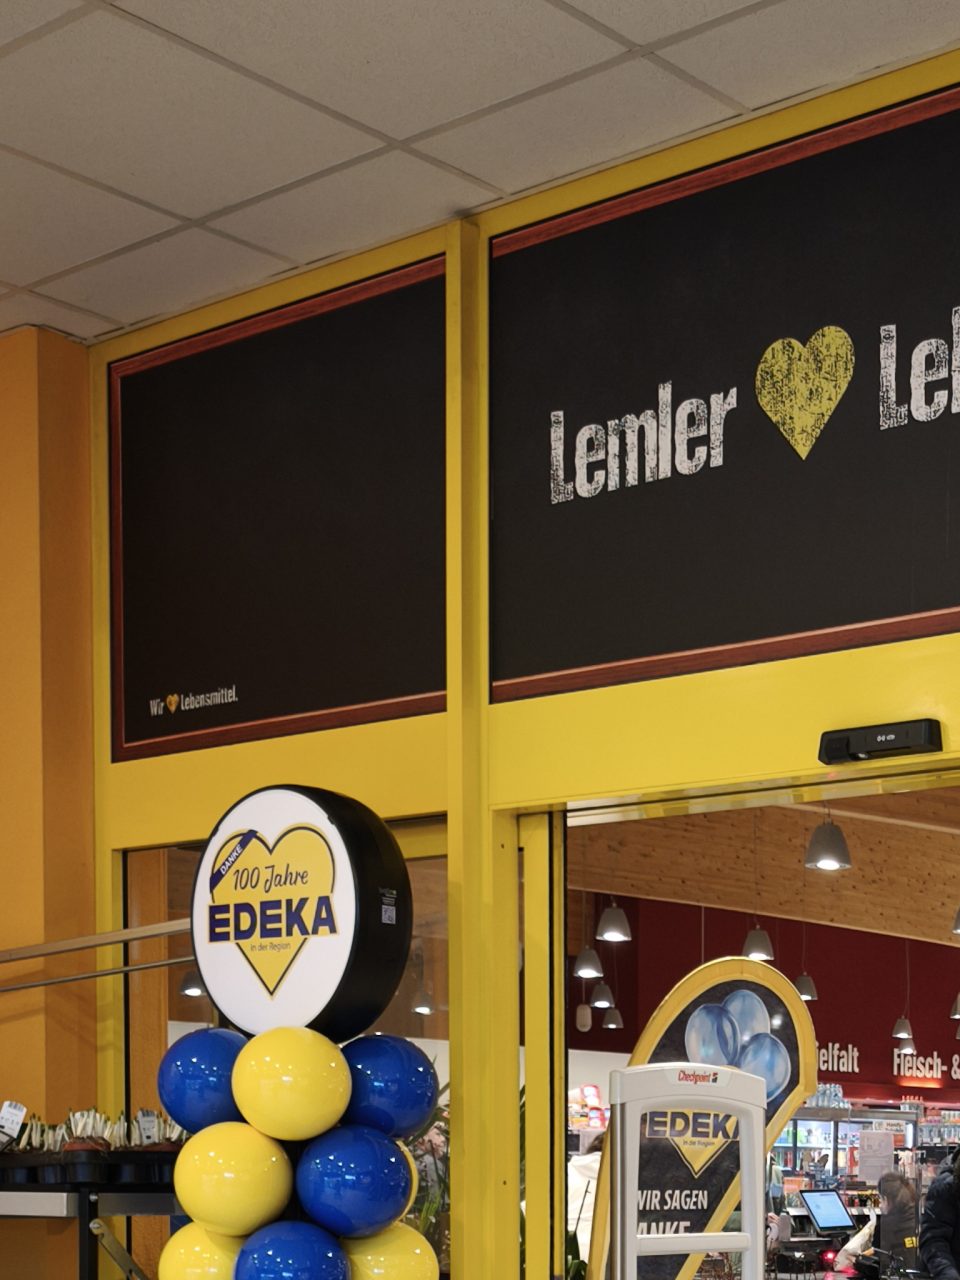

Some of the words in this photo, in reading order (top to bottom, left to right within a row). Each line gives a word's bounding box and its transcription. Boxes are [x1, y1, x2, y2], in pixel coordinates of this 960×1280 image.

[550, 380, 738, 505] Lemler
[149, 698, 165, 717] Wir
[220, 844, 243, 875] DANKE
[233, 867, 260, 891] 100
[264, 863, 309, 893] Jahre
[208, 895, 338, 943] EDEKA
[893, 1048, 947, 1079] Fleisch-
[951, 1055, 960, 1080] &
[649, 1110, 739, 1139] EDEK
[663, 1189, 708, 1211] SAGEN
[637, 1221, 691, 1235] ANKE
